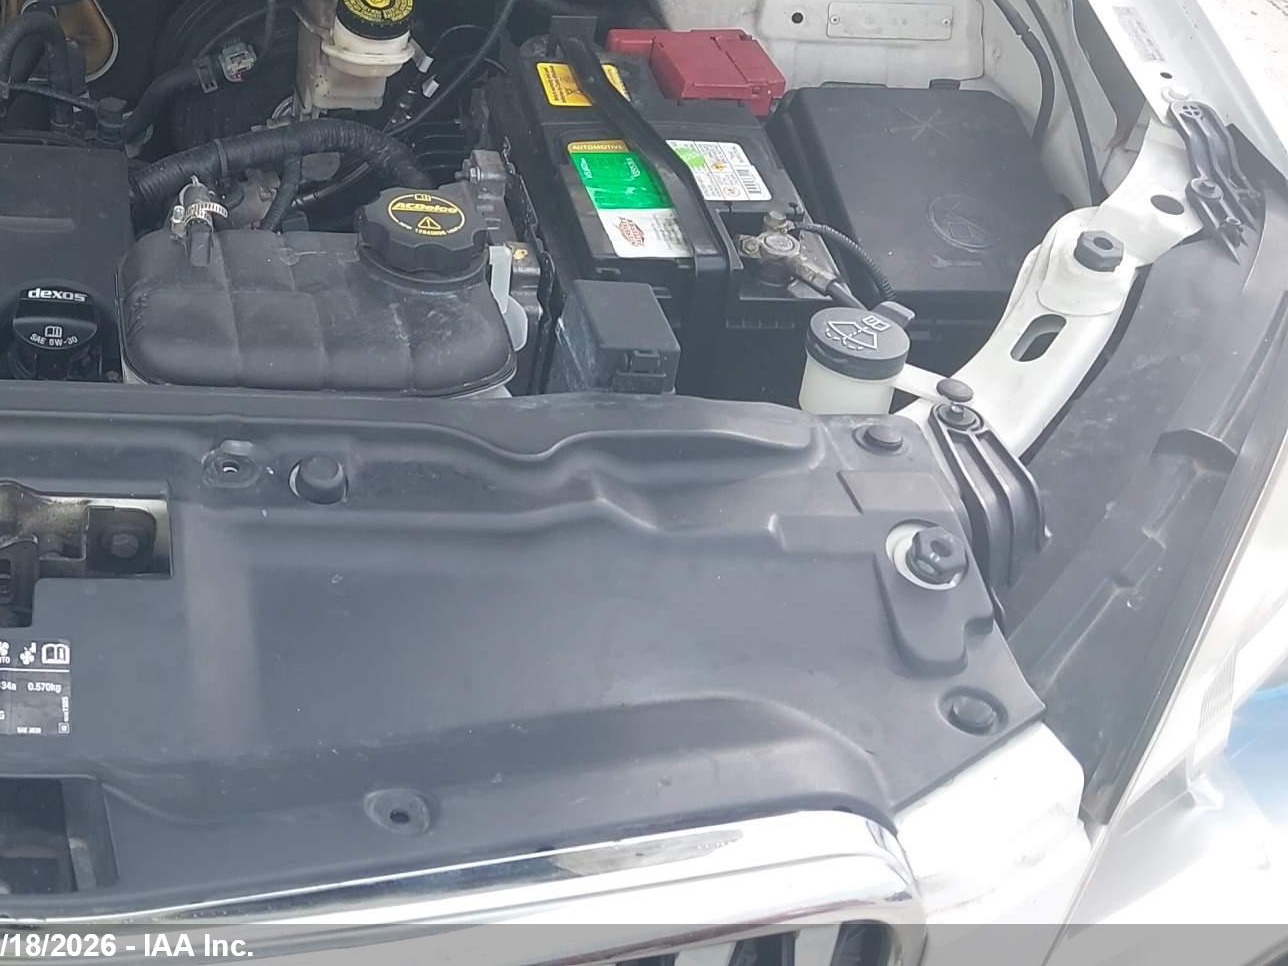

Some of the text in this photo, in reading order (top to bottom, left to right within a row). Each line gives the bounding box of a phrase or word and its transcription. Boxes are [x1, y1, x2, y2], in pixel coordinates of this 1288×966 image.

[391, 201, 459, 214] ACDelco
[27, 287, 89, 303] dexos
[29, 333, 47, 345] SAE
[27, 682, 62, 694] 0.570kg
